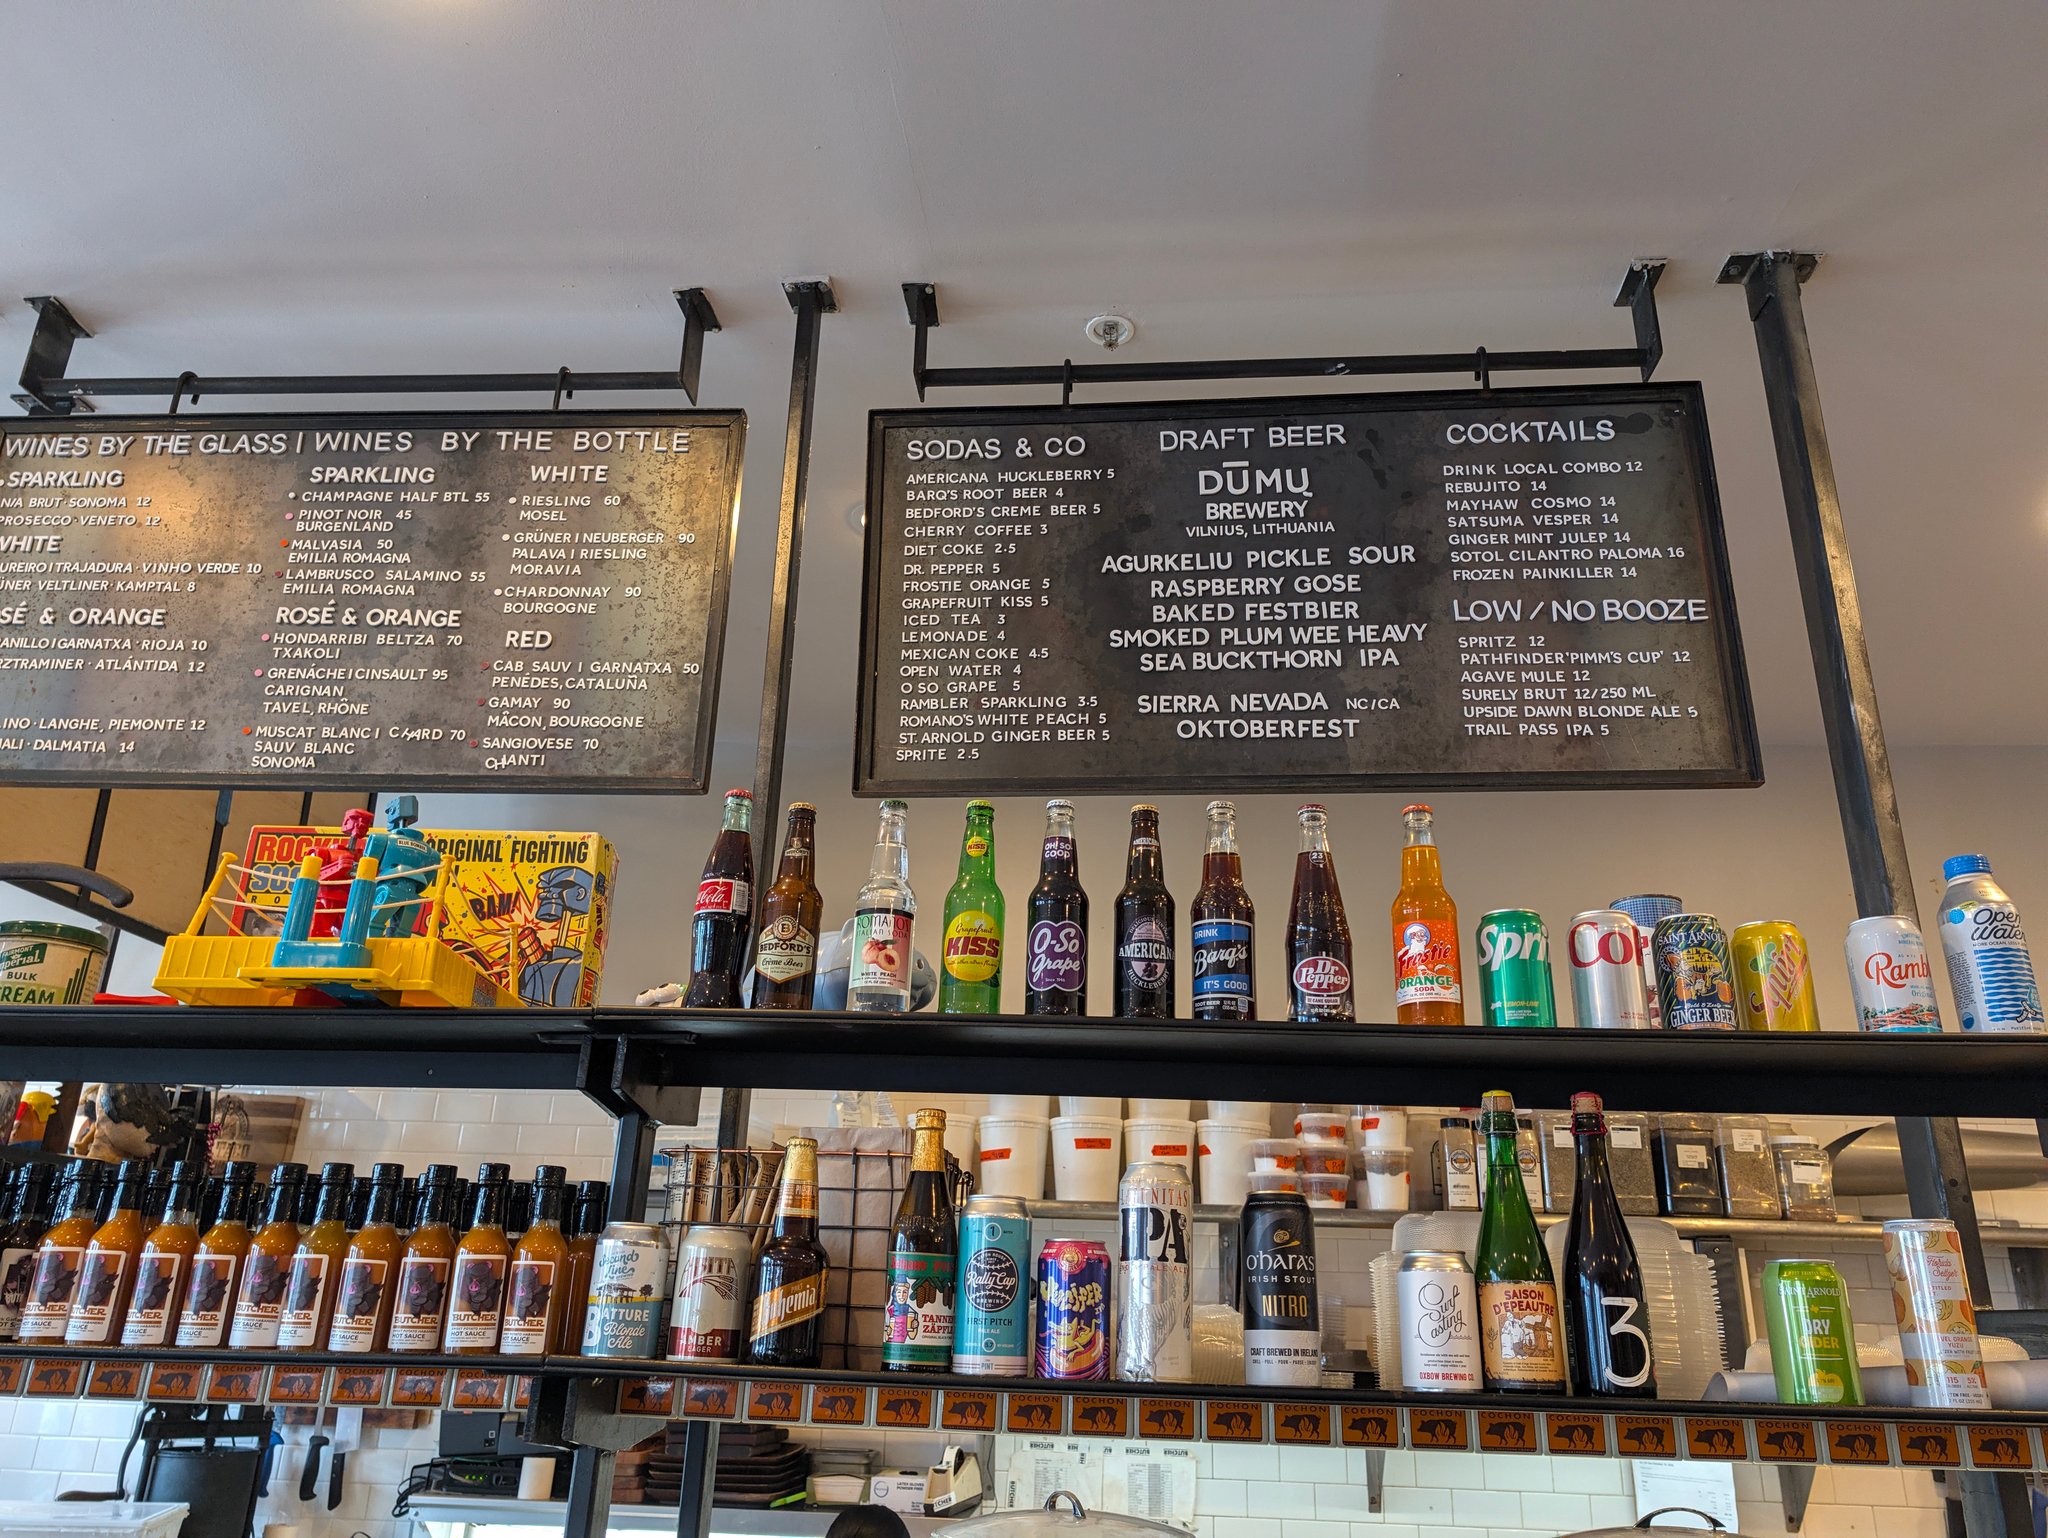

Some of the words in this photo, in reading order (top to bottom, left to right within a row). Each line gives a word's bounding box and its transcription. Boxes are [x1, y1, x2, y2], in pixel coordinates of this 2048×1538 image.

[1160, 428, 1254, 451] DRAFT
[1269, 425, 1346, 447] BEER
[1447, 420, 1615, 444] COCKTAILS
[6, 437, 90, 458] WINES
[98, 436, 133, 454] BY
[143, 435, 191, 454] THE
[199, 433, 287, 453] GLASS
[316, 432, 412, 451] WINES
[441, 432, 479, 451] BY
[497, 431, 552, 450] THE
[574, 431, 689, 454] BOTTLE
[907, 439, 1001, 459] SODAS
[1016, 438, 1032, 457] &
[1045, 436, 1085, 456] CO
[7, 470, 122, 487] SPARKLING
[310, 467, 434, 483] SPARKLING
[531, 466, 608, 481] WHITE
[906, 473, 988, 484] AMERICANA
[998, 470, 1102, 482] HUCKLEBERRY
[1108, 469, 1114, 478] 5
[1446, 481, 1520, 493] REBUJITO
[1531, 481, 1546, 491] 14
[302, 491, 393, 501] CHAMPAGNE
[400, 492, 438, 502] HALF
[443, 492, 469, 502] BTL
[475, 493, 490, 502] 55
[522, 496, 590, 506] RIESLING
[604, 496, 620, 505] 60
[299, 510, 343, 519] PINOT
[347, 510, 382, 519] NOIR
[396, 510, 411, 519] 45
[520, 510, 566, 520] MOSEL
[1207, 500, 1308, 520] BREWERY
[1186, 525, 1247, 538] VILNIUS,
[1253, 522, 1335, 534] LITHUANIA
[1102, 552, 1232, 573] AGURKELIU
[1247, 548, 1331, 568] PICKLE
[1349, 545, 1415, 564] SOUR
[510, 564, 581, 575] MORAVIA
[1151, 577, 1284, 597] RASPBERRY
[1294, 574, 1361, 593] GOSE
[276, 599, 335, 624] ROSÉ
[342, 608, 356, 625] &
[366, 609, 461, 626] ORANGE
[1153, 604, 1234, 622] BAKED
[1246, 601, 1359, 621] FESTBIER
[1454, 600, 1521, 621] LOW
[1552, 600, 1595, 622] NO
[1603, 599, 1708, 621] BOOZE
[506, 631, 552, 647] RED
[902, 631, 987, 642] LEMONADE
[997, 631, 1005, 640] 4
[1110, 628, 1209, 647] SMOKED
[1221, 627, 1282, 645] PLUM
[1290, 626, 1340, 644] WEE
[1348, 624, 1427, 643] HEAVY
[273, 648, 339, 658] TXAKOLI
[1141, 653, 1186, 671] SEA
[1193, 649, 1341, 670] BUCKTHORN
[1360, 648, 1399, 666] IPA
[265, 685, 343, 696] CARIGNAN
[1138, 695, 1219, 713] SIERRA
[1231, 692, 1328, 712] NEVADA
[1177, 719, 1359, 738] OKTOBERFEST
[1465, 724, 1511, 735] TRAIL
[1519, 724, 1558, 735] PASS
[1567, 724, 1593, 735] IPA
[1601, 725, 1609, 735] 5
[251, 756, 315, 768] SONOMA
[510, 840, 589, 864] FIGHTING
[1044, 850, 1070, 858] GOOD
[1312, 852, 1324, 860] 23
[469, 891, 520, 921] BAM!
[955, 923, 994, 935] Grapefruit
[1194, 928, 1219, 939] DRINK
[1658, 932, 1686, 946] SAINT
[760, 943, 811, 955] BEDFORD'S
[946, 936, 1000, 959] KISS
[784, 958, 804, 968] Beer
[1194, 944, 1249, 977] Barq's
[1316, 959, 1339, 975] Dr
[1397, 941, 1452, 978] Frostie
[7, 971, 38, 981] BULK
[1127, 969, 1170, 990] HUCKLEBERRY
[1299, 968, 1346, 989] Pepper
[1399, 975, 1453, 990] ORANGE
[1750, 933, 1802, 1022] Squirt
[1203, 980, 1220, 989] IT'S
[1223, 980, 1246, 991] GOOD
[1670, 1009, 1711, 1028] GINGER
[1713, 1008, 1736, 1025] BEER
[1120, 1207, 1188, 1264] IPA
[967, 1271, 998, 1289] Rally
[997, 1271, 1016, 1289] Cap
[1246, 1275, 1278, 1284] IRISH
[1284, 1275, 1315, 1285] STOUT
[1418, 1280, 1460, 1322] Surf
[1503, 1289, 1544, 1301] SAISON
[26, 1303, 68, 1312] BUTCHER
[1261, 1295, 1308, 1318] NITRO
[1492, 1300, 1555, 1317] D'EPEAUTRE
[452, 1313, 497, 1321] BUTCHER
[967, 1317, 987, 1326] FIRST
[989, 1317, 1013, 1326] PITCH
[603, 1321, 646, 1337] Blonde
[1801, 1318, 1831, 1335] DRY
[608, 1335, 633, 1349] Ale
[680, 1336, 722, 1347] AMBER
[1601, 1296, 1651, 1387] 3
[1799, 1336, 1840, 1349] CIDER
[1250, 1347, 1265, 1357] CRAFT
[1266, 1347, 1292, 1357] BREWED
[1293, 1347, 1299, 1357] IN
[981, 1362, 994, 1371] PINT
[1419, 1371, 1440, 1380] OXBOW
[1441, 1373, 1467, 1381] BREWING
[753, 1382, 804, 1391] COCHON
[880, 1389, 930, 1397] COCHON
[1209, 1402, 1262, 1410] COCHON
[1481, 1411, 1532, 1420] COCHON
[1828, 1423, 1882, 1432] COCHON
